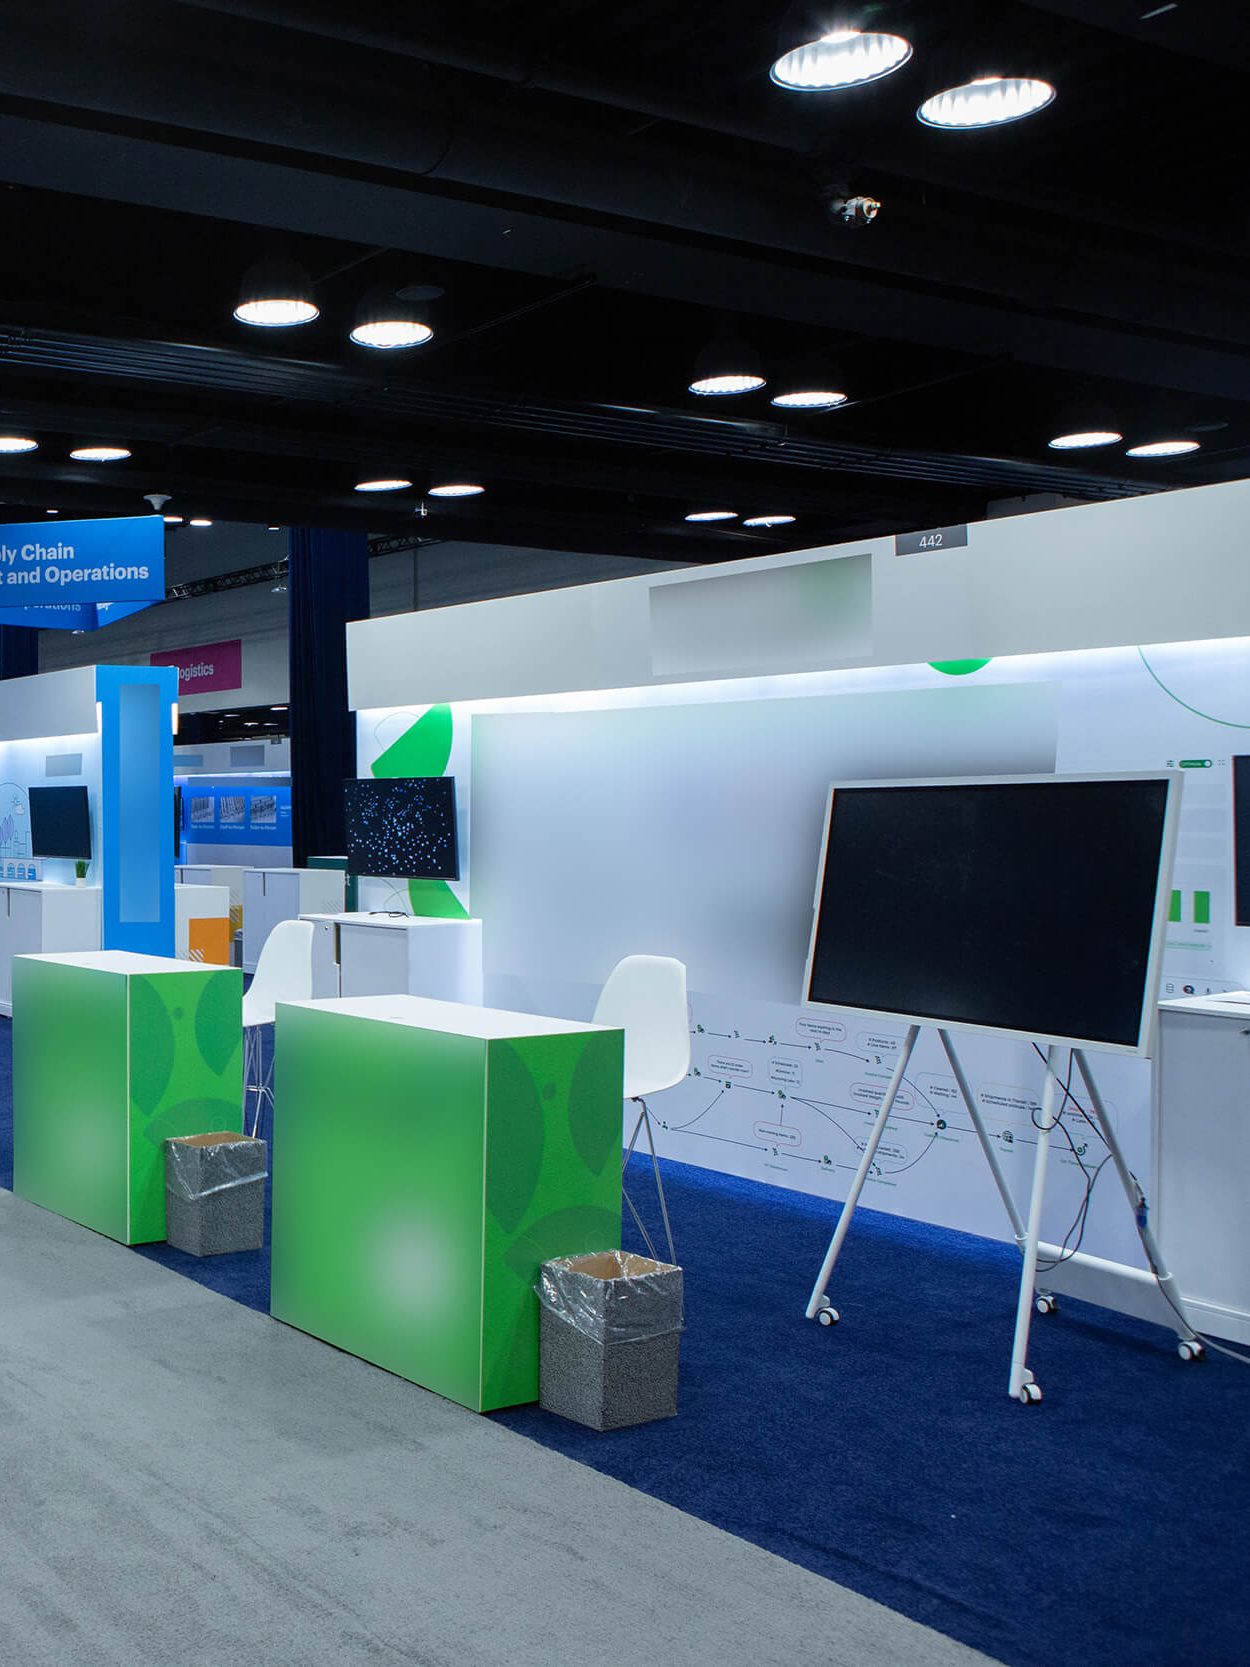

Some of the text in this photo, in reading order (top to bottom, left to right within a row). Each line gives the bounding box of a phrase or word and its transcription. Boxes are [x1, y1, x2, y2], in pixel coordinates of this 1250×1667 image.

[918, 534, 943, 548] 442
[21, 542, 75, 561] Chain
[7, 567, 40, 585] and
[44, 563, 150, 586] Operations
[179, 662, 214, 681] ogistics
